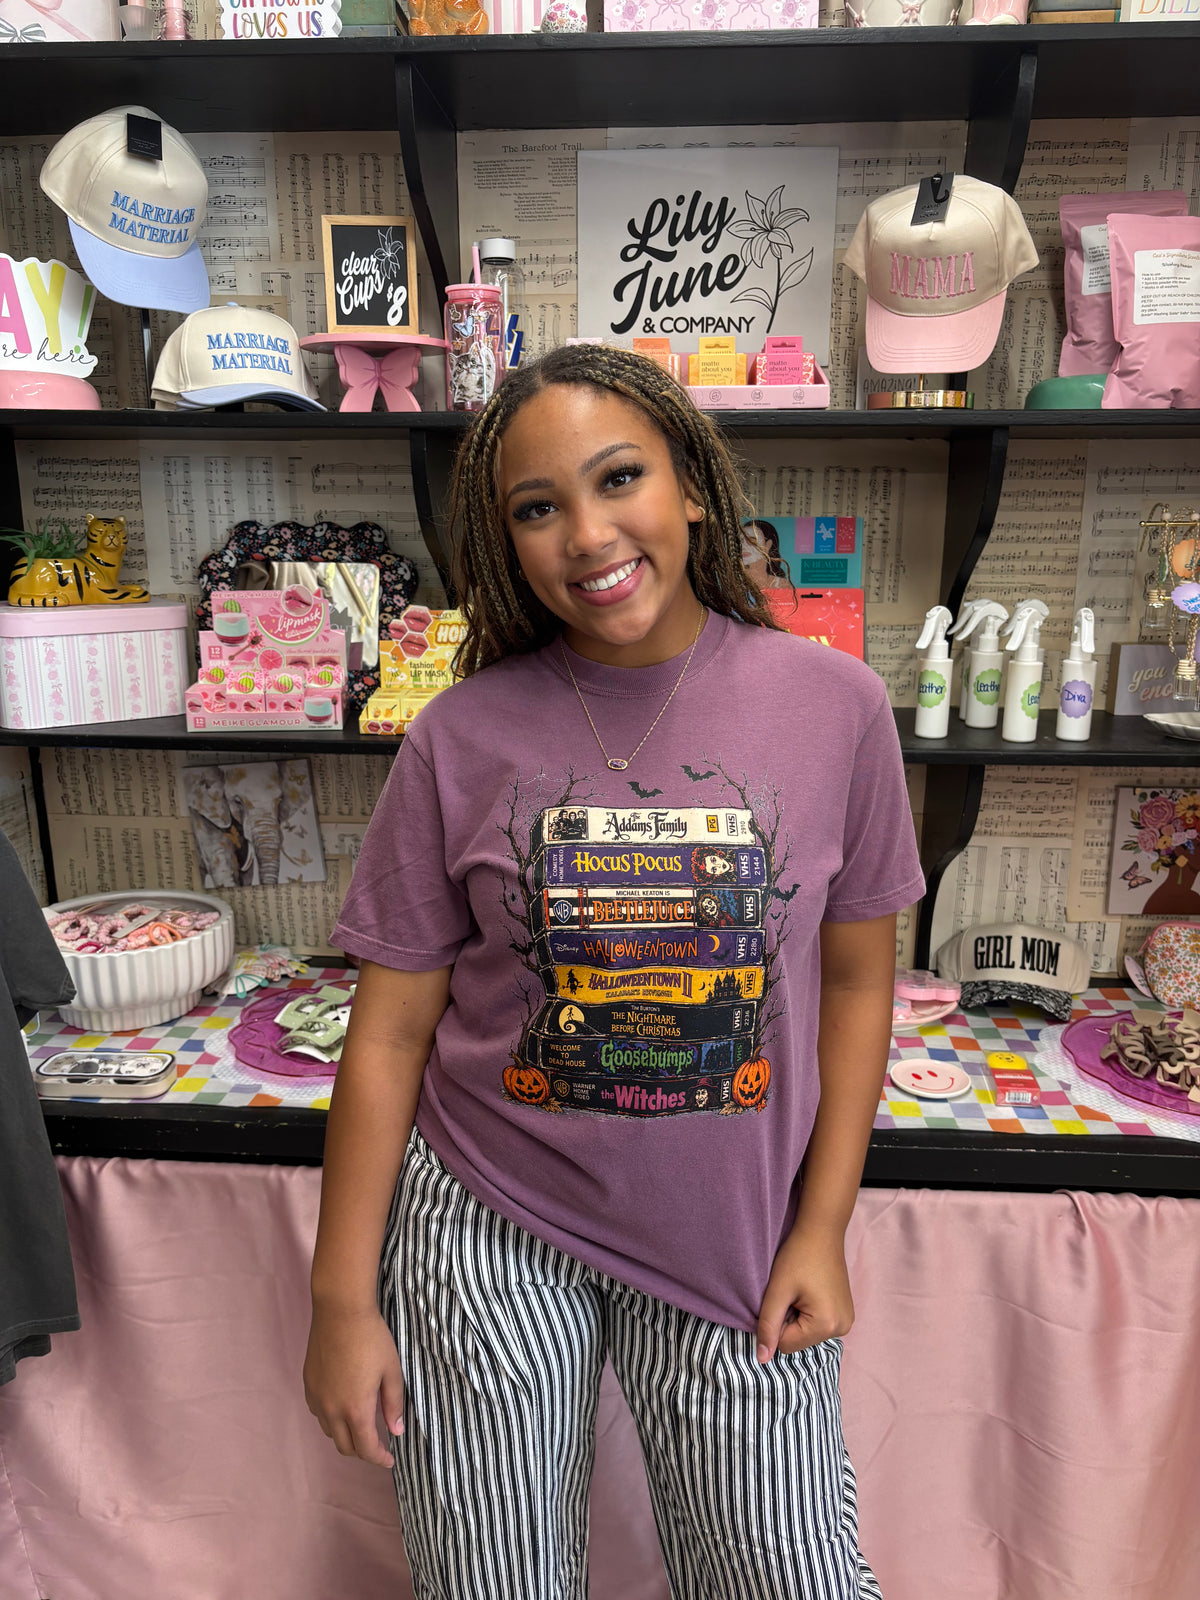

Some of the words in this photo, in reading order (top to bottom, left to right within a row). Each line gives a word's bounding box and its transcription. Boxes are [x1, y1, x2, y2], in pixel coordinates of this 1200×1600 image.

[233, 11, 288, 38] LOVES
[298, 10, 323, 37] US
[521, 143, 557, 153] Barefoot
[110, 190, 196, 225] MARRIAGE
[108, 212, 190, 244] MATERIAL
[620, 190, 737, 263] Lily
[341, 251, 378, 277] clear
[889, 252, 977, 300] MAMA
[336, 270, 385, 315] Cups
[386, 283, 408, 327] $8
[611, 253, 748, 335] June
[642, 317, 655, 334] &
[660, 317, 755, 334] COMPANY
[37, 337, 94, 365] here
[207, 333, 291, 356] MARRIAGE
[212, 353, 293, 375] MATERIAL
[210, 647, 221, 655] 12
[409, 661, 435, 669] fashion
[410, 670, 423, 678] LIP
[424, 670, 446, 678] MASK
[919, 683, 945, 695] eather
[1128, 667, 1167, 694] you
[1064, 689, 1087, 704] Diva
[1140, 683, 1174, 703] eno
[212, 719, 247, 727] MEIKE
[248, 718, 301, 727] GLAMOUR
[602, 812, 653, 841] Addams
[647, 811, 688, 841] Family
[709, 818, 716, 829] PG
[727, 815, 736, 834] VHS
[570, 851, 631, 873] HOCUS
[630, 852, 683, 876] POCUS
[740, 854, 750, 876] VHS
[753, 856, 761, 876] 2144
[554, 904, 570, 920] WB
[592, 900, 693, 923] BEETLEJUICE
[745, 895, 754, 919] VHS
[553, 942, 579, 953] Disney
[583, 936, 698, 964] HALLOWEENTOWN
[737, 936, 746, 959] VHS
[974, 935, 1015, 970] GIRL
[1020, 936, 1061, 977] MOM
[588, 972, 682, 990] HALLOWEENTOWN
[681, 971, 694, 999] II
[745, 972, 754, 993] VHS
[611, 1011, 626, 1020] THE
[626, 1011, 677, 1026] NIGHTMARE
[611, 1024, 635, 1034] BEFORE
[636, 1023, 681, 1037] CHRISTMAS
[550, 1043, 581, 1052] WELCOME
[600, 1040, 694, 1075] Goosebumps
[548, 1057, 564, 1066] DEAD
[565, 1059, 586, 1068] HOUSE
[572, 1082, 596, 1090] WARNER
[573, 1093, 590, 1101] VIDEO
[600, 1089, 615, 1100] the
[613, 1084, 687, 1110] Witches
[721, 1080, 730, 1100] VHS
